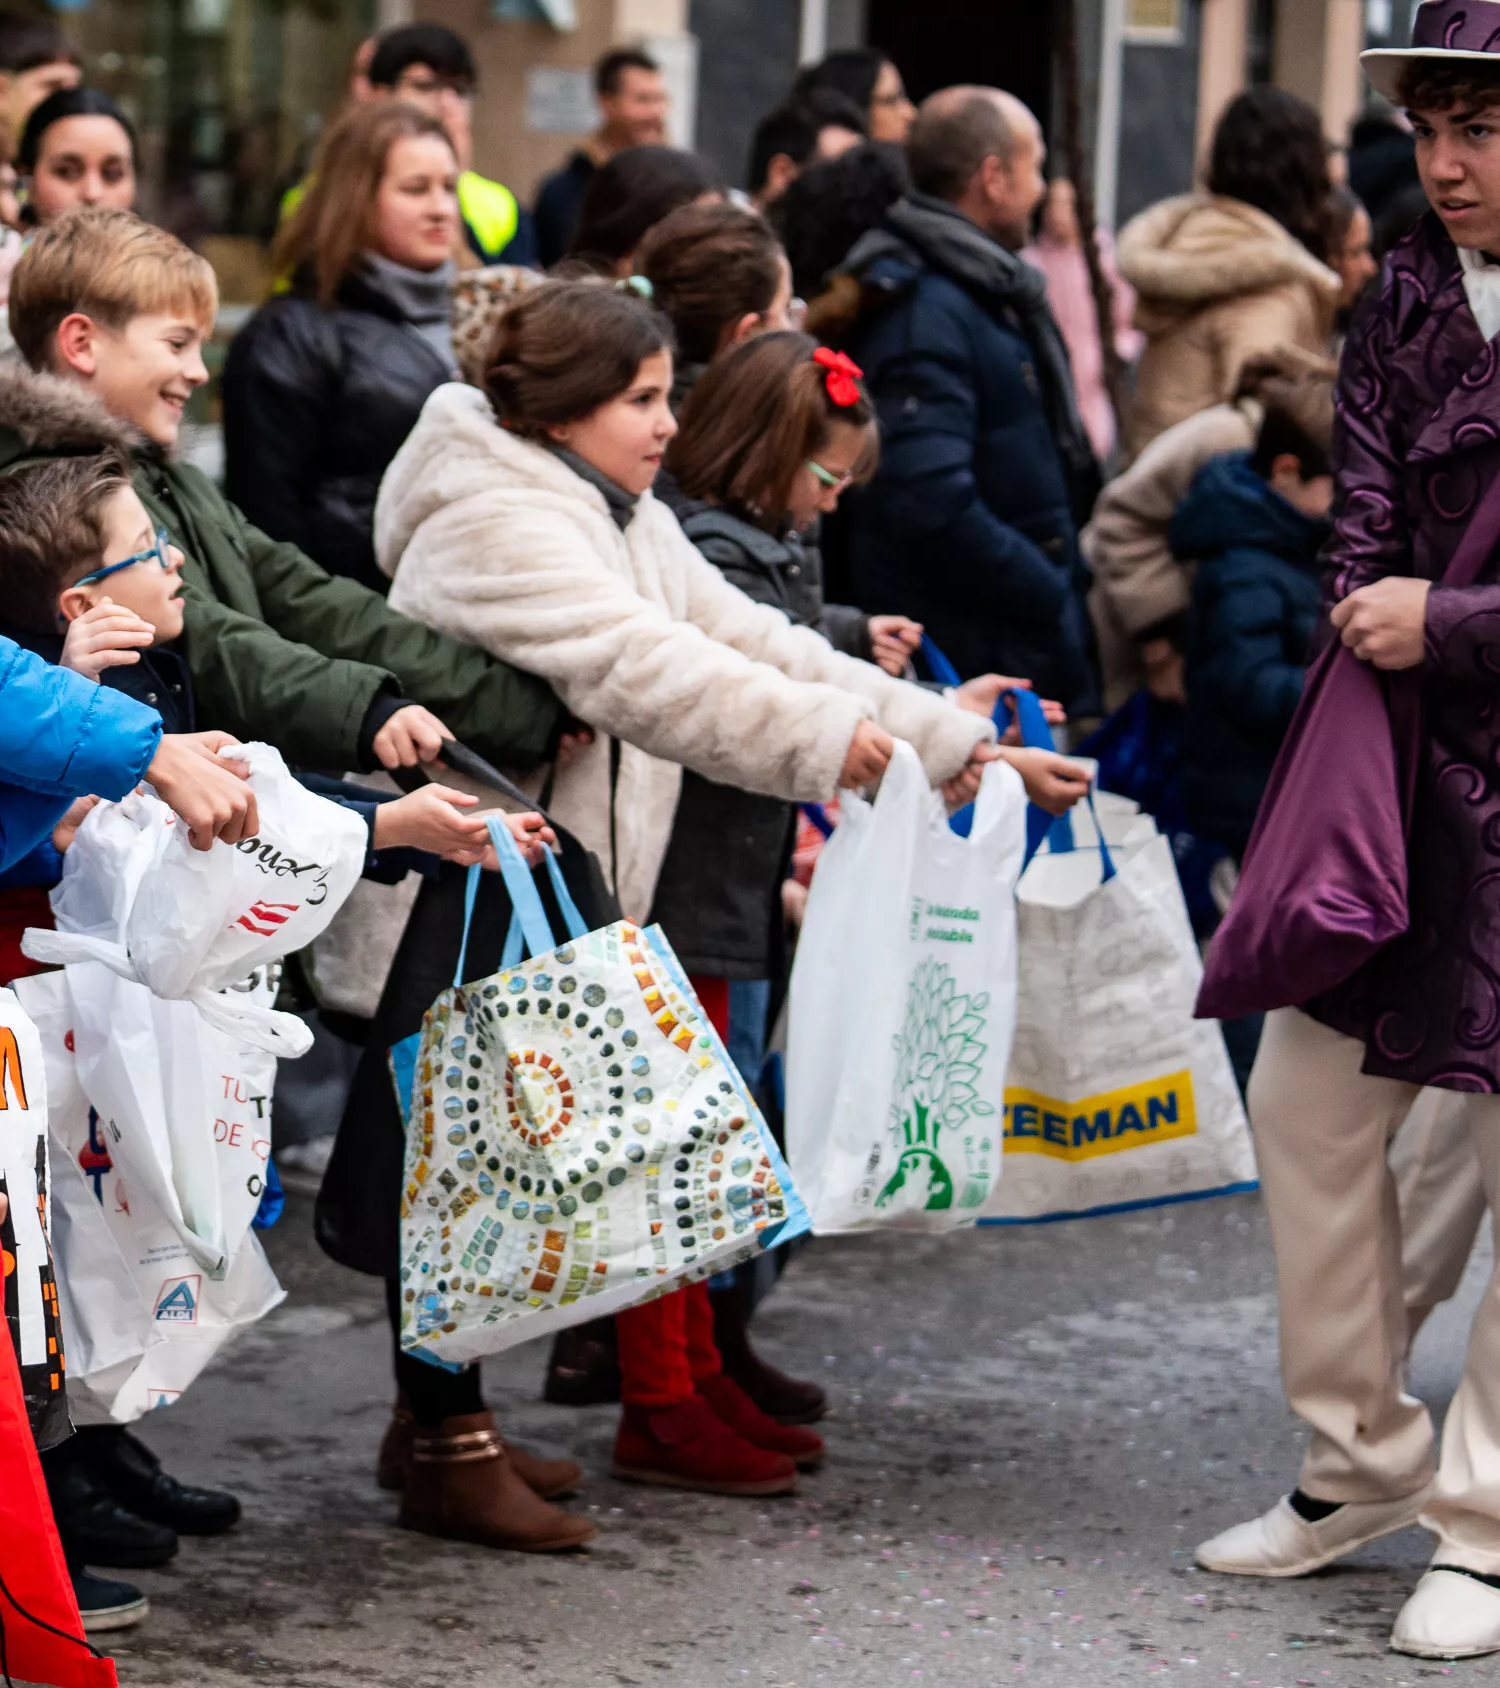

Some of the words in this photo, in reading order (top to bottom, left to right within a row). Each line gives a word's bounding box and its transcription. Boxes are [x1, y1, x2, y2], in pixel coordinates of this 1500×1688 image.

[214, 1118, 244, 1147] DE
[1003, 1090, 1179, 1148] EEMAN
[157, 1310, 191, 1320] ALDI
